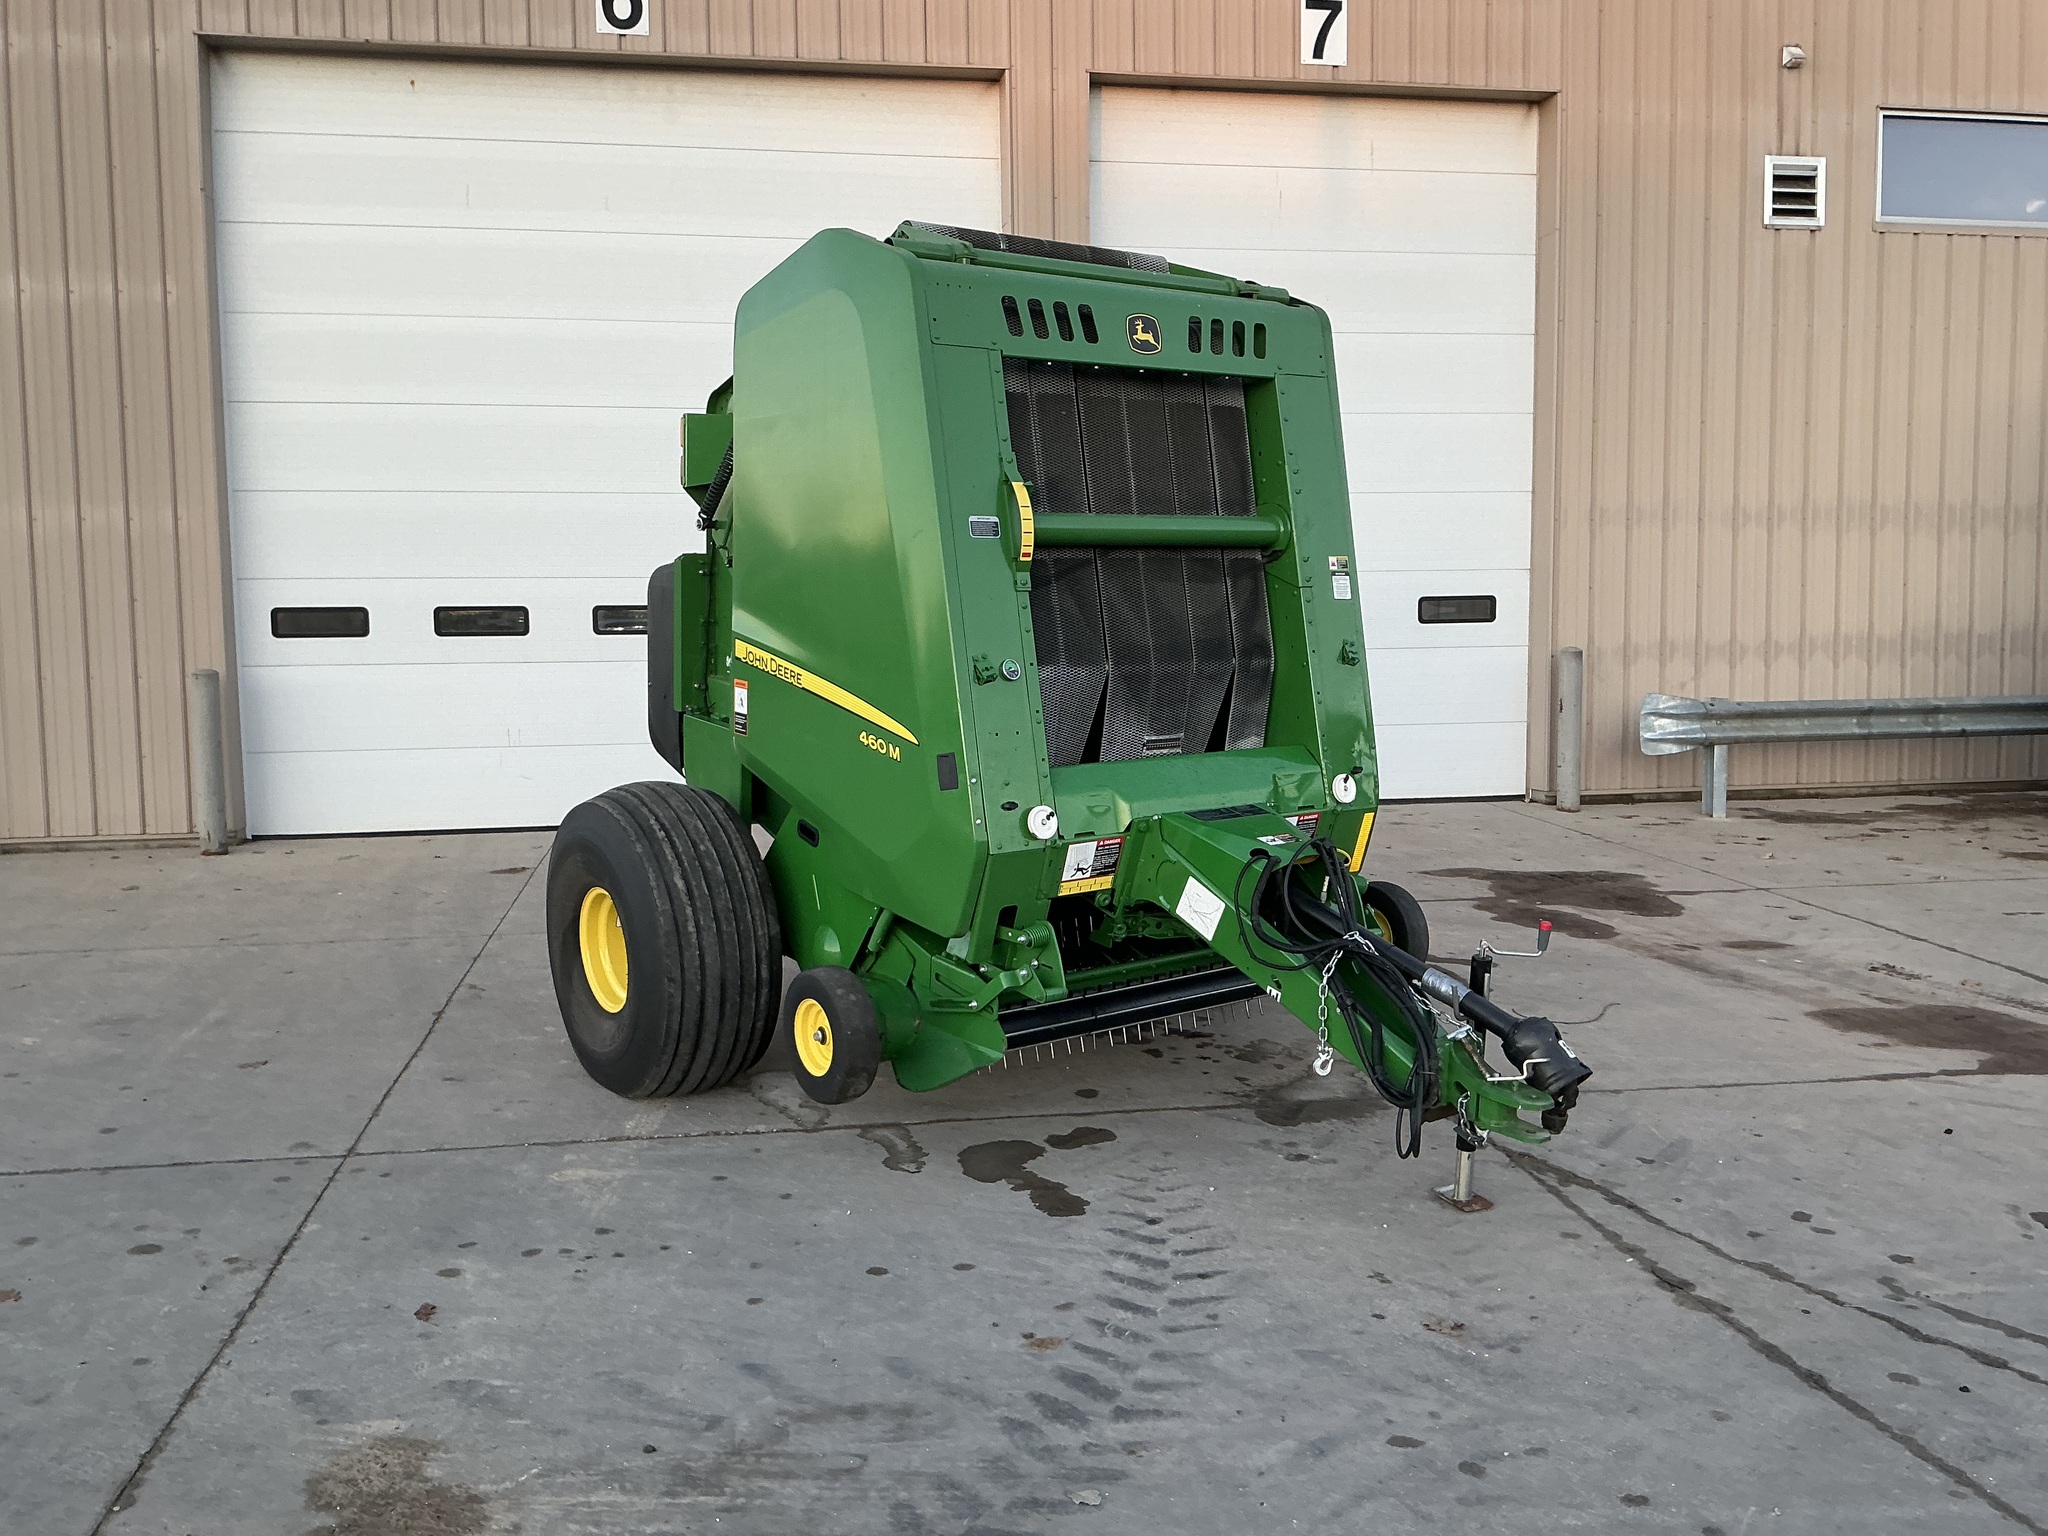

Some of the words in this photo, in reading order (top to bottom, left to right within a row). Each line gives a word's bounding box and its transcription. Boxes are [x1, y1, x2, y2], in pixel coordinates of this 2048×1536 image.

[1305, 0, 1343, 60] 7
[742, 646, 768, 670] JOHN
[770, 658, 802, 686] DEERE
[859, 730, 887, 755] 460
[888, 743, 901, 762] M
